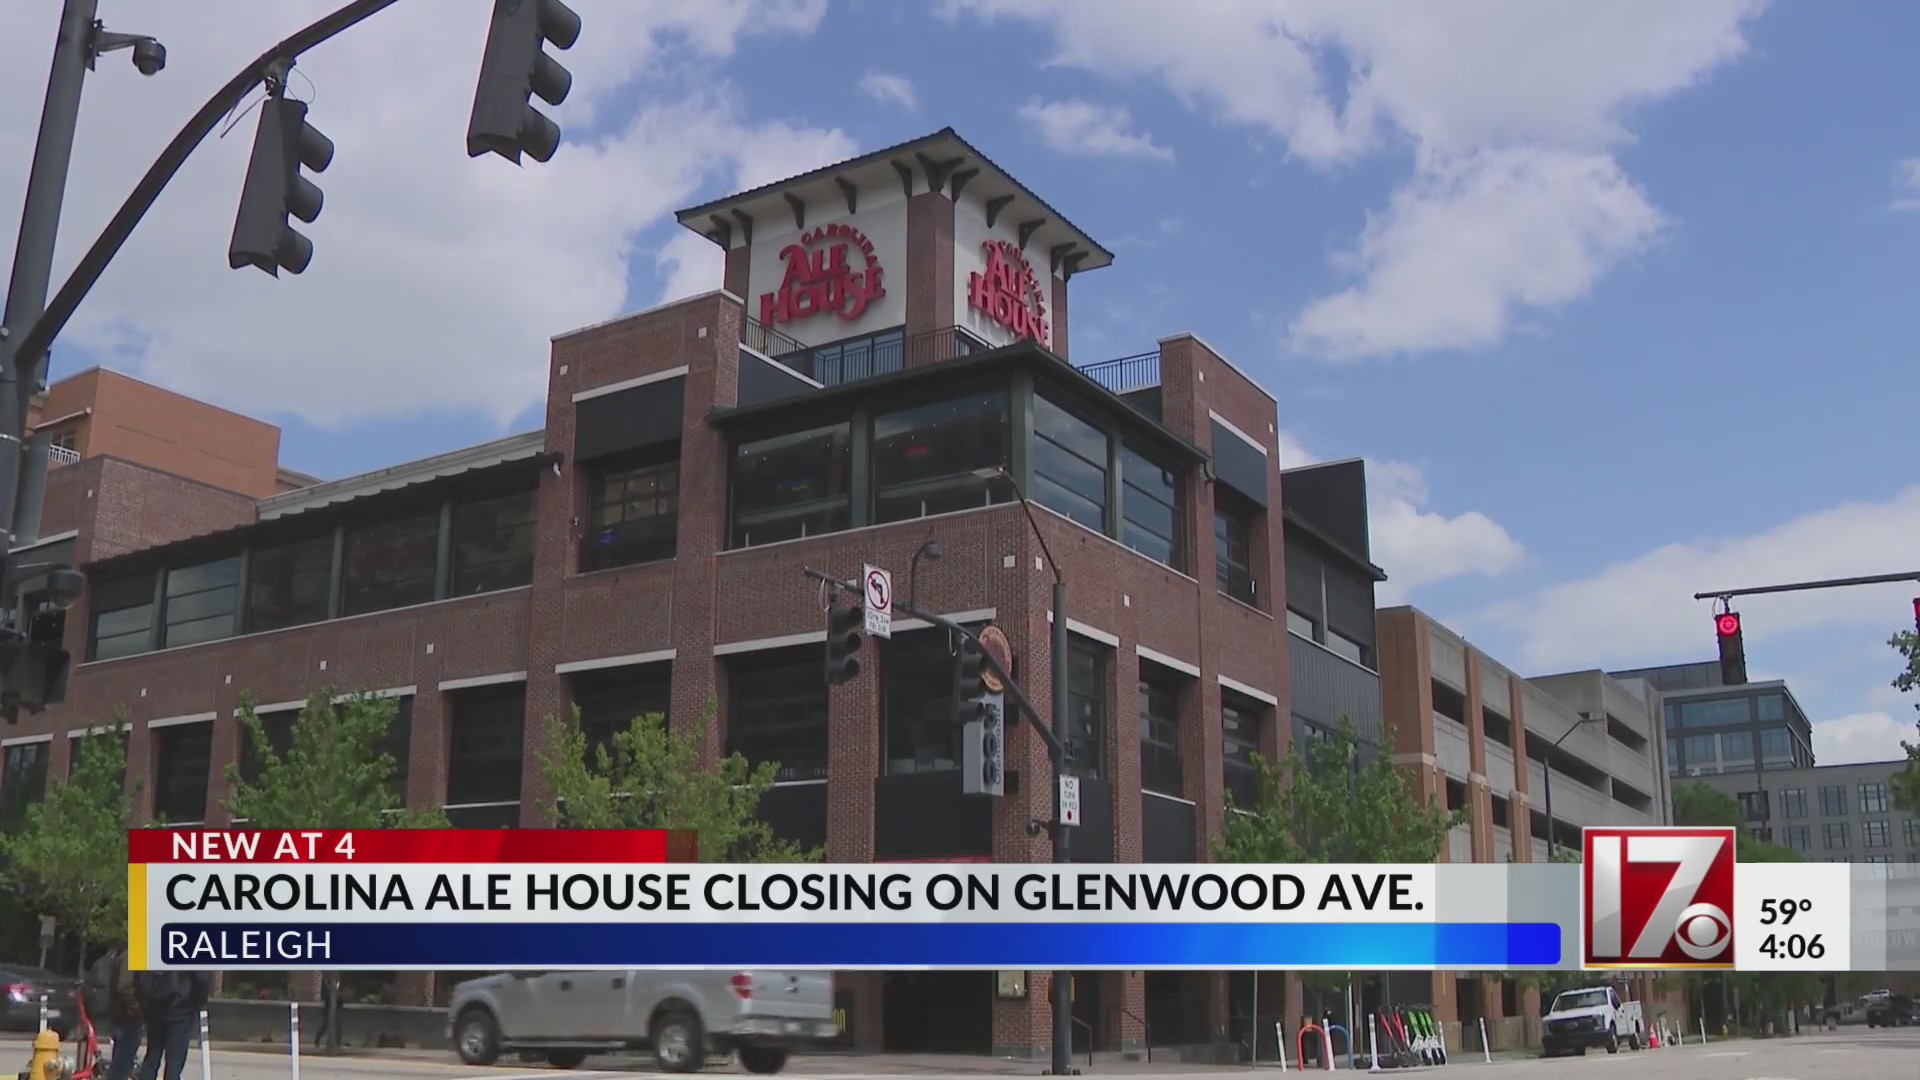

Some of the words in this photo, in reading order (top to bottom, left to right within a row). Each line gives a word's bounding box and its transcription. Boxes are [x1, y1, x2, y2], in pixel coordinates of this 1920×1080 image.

[760, 266, 886, 327] HOUSE
[779, 243, 851, 290] ALE
[982, 240, 1029, 307] ALE
[967, 270, 1049, 347] HOUSE
